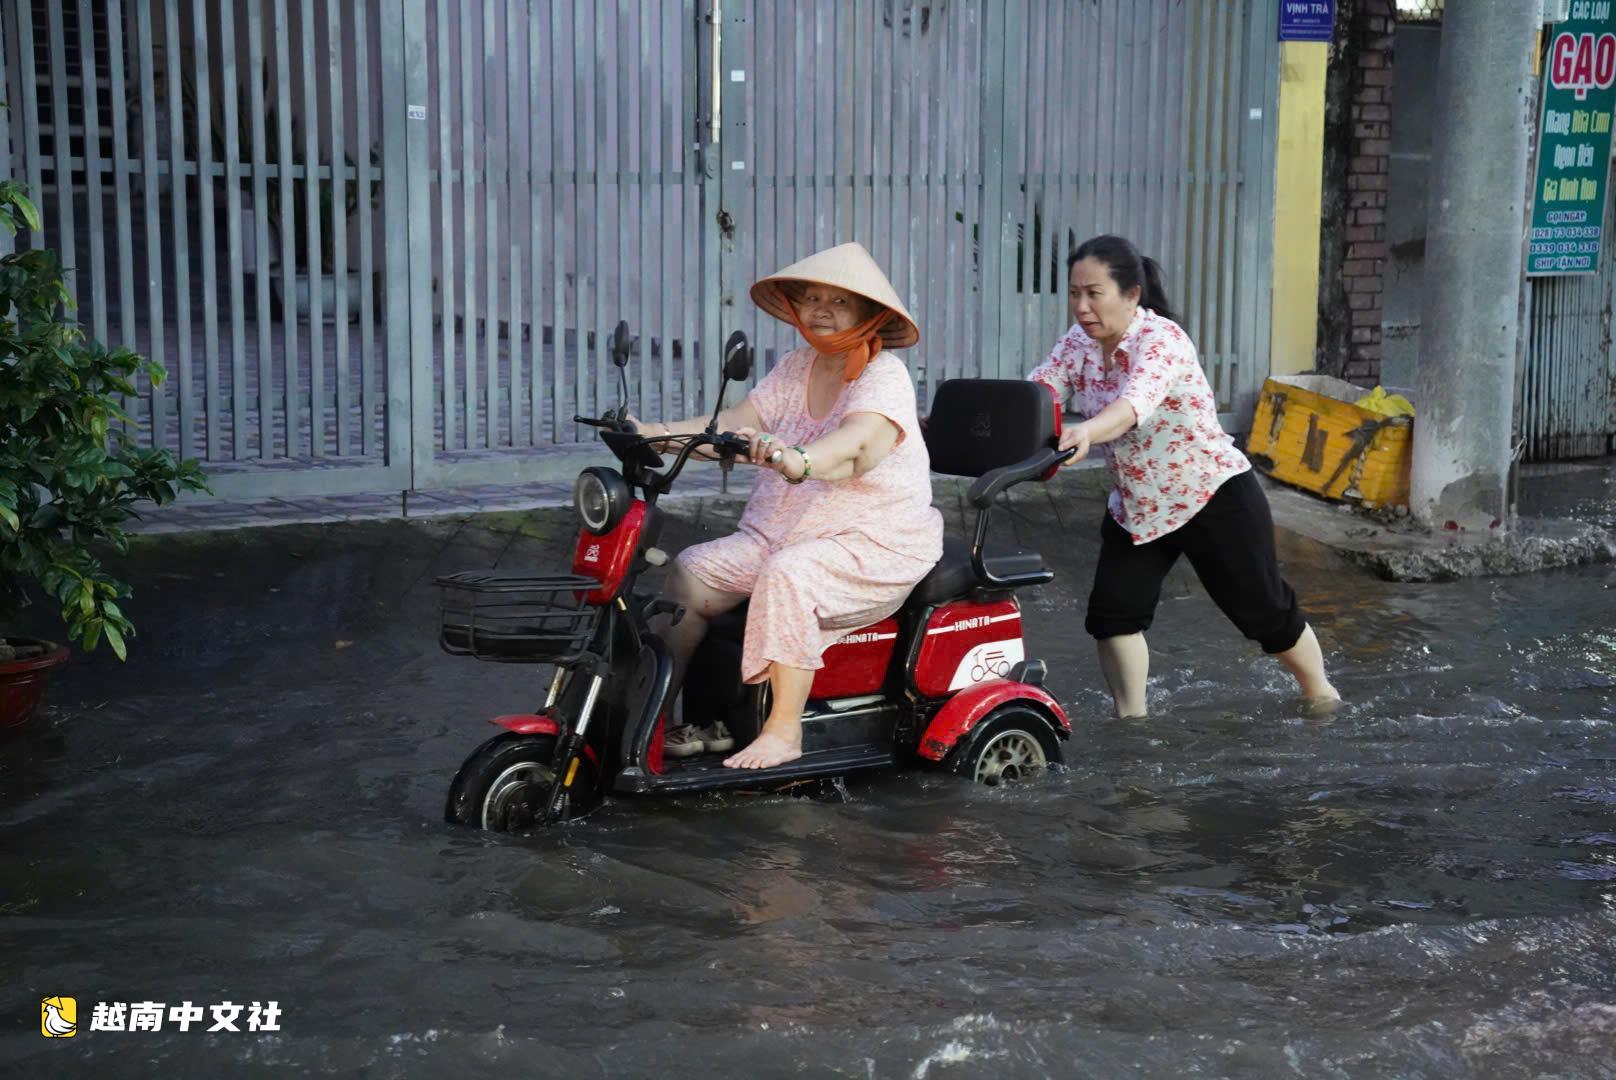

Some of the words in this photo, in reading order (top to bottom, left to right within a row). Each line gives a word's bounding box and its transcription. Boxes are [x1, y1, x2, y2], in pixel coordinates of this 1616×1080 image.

[1551, 32, 1616, 101] GẠO
[1529, 242, 1556, 255] 0339
[1535, 256, 1556, 270] SHIP
